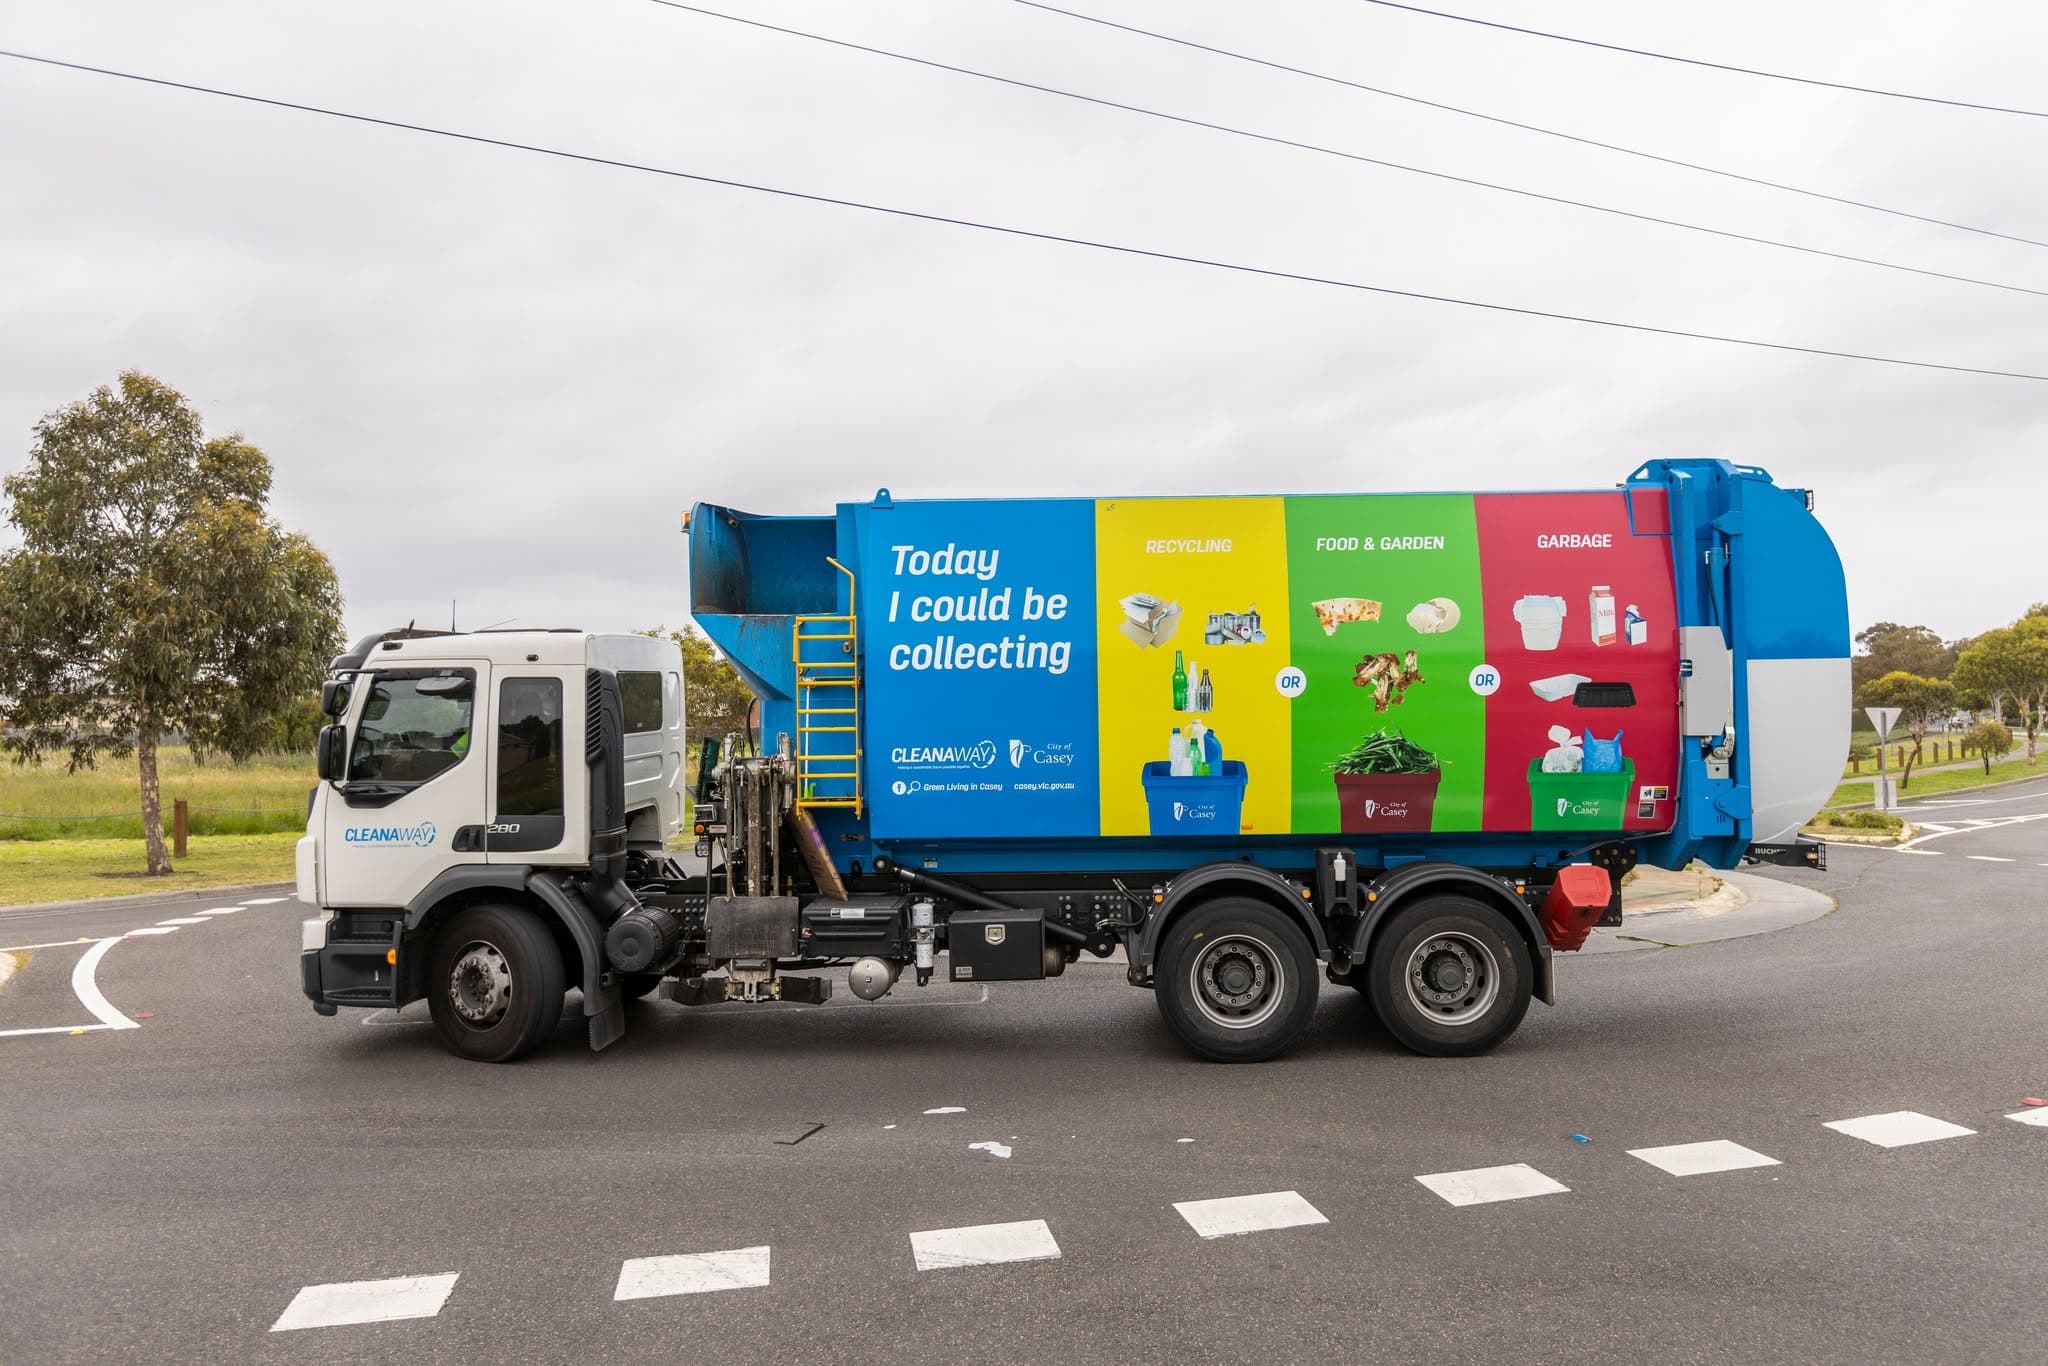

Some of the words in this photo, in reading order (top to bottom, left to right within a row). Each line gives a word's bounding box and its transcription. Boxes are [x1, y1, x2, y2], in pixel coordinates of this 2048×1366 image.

[1145, 539, 1233, 553] RECYCLING
[1316, 537, 1358, 551] FOOD
[1363, 537, 1375, 551] &
[1380, 536, 1445, 550] GARDEN
[1537, 534, 1612, 548] GARBAGE
[891, 543, 1000, 581] Today
[888, 591, 900, 622] I
[911, 587, 1012, 623] could
[1022, 586, 1068, 621] be
[889, 634, 1071, 675] collecting
[1281, 675, 1301, 689] OR
[1475, 673, 1495, 687] OR
[1047, 743, 1061, 751] City
[1063, 743, 1072, 751] of
[891, 746, 990, 763] CLEANAWAY
[1033, 750, 1075, 766] Casey
[923, 783, 945, 791] Green
[946, 783, 969, 792] Living
[971, 782, 978, 791] in
[979, 782, 1003, 792] Casey
[1014, 781, 1075, 791] casey.vic.gov.au
[1189, 809, 1216, 820] Casey
[1380, 806, 1408, 818] Casey
[1572, 805, 1600, 816] Casey
[345, 827, 432, 842] CLEANAWAY
[487, 823, 520, 833] 280
